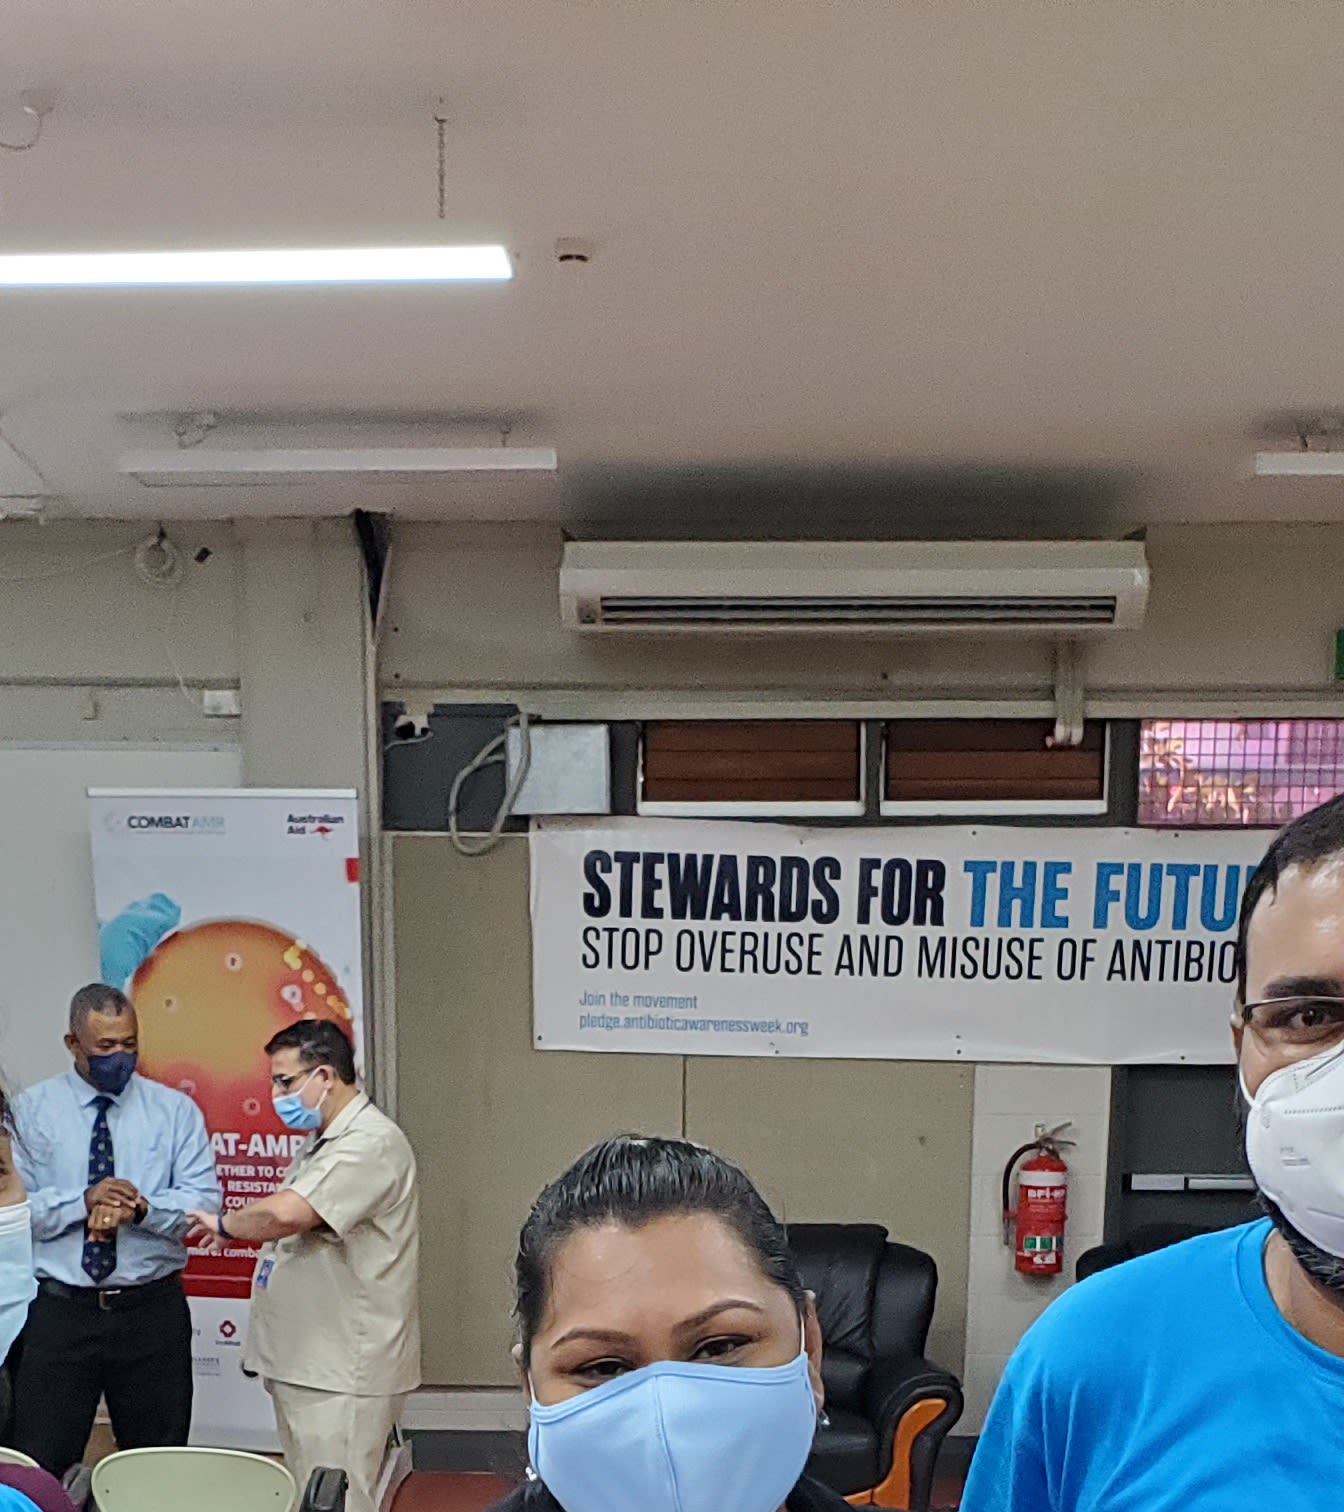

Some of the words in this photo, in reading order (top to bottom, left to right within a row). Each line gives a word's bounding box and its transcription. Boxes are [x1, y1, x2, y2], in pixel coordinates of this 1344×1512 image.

[127, 815, 190, 829] COMBAT
[287, 814, 345, 824] Australian
[287, 825, 306, 835] Aid
[583, 850, 842, 925] STEWARDS
[856, 857, 946, 927] FOR
[964, 860, 1072, 929] THE
[1093, 862, 1250, 932] FUTU
[581, 926, 663, 971] STOP
[675, 929, 824, 976] OVERUSE
[834, 934, 903, 978] AND
[917, 936, 1044, 981] MISUSE
[1057, 938, 1097, 982] OF
[1106, 939, 1238, 984] ANTIBIO
[579, 990, 606, 1007] Join
[610, 991, 630, 1008] the
[632, 993, 698, 1009] movement
[579, 1013, 809, 1037] pledge.antibioticawarenessweek.org
[216, 1164, 256, 1177] ETHER
[257, 1166, 274, 1178] TO
